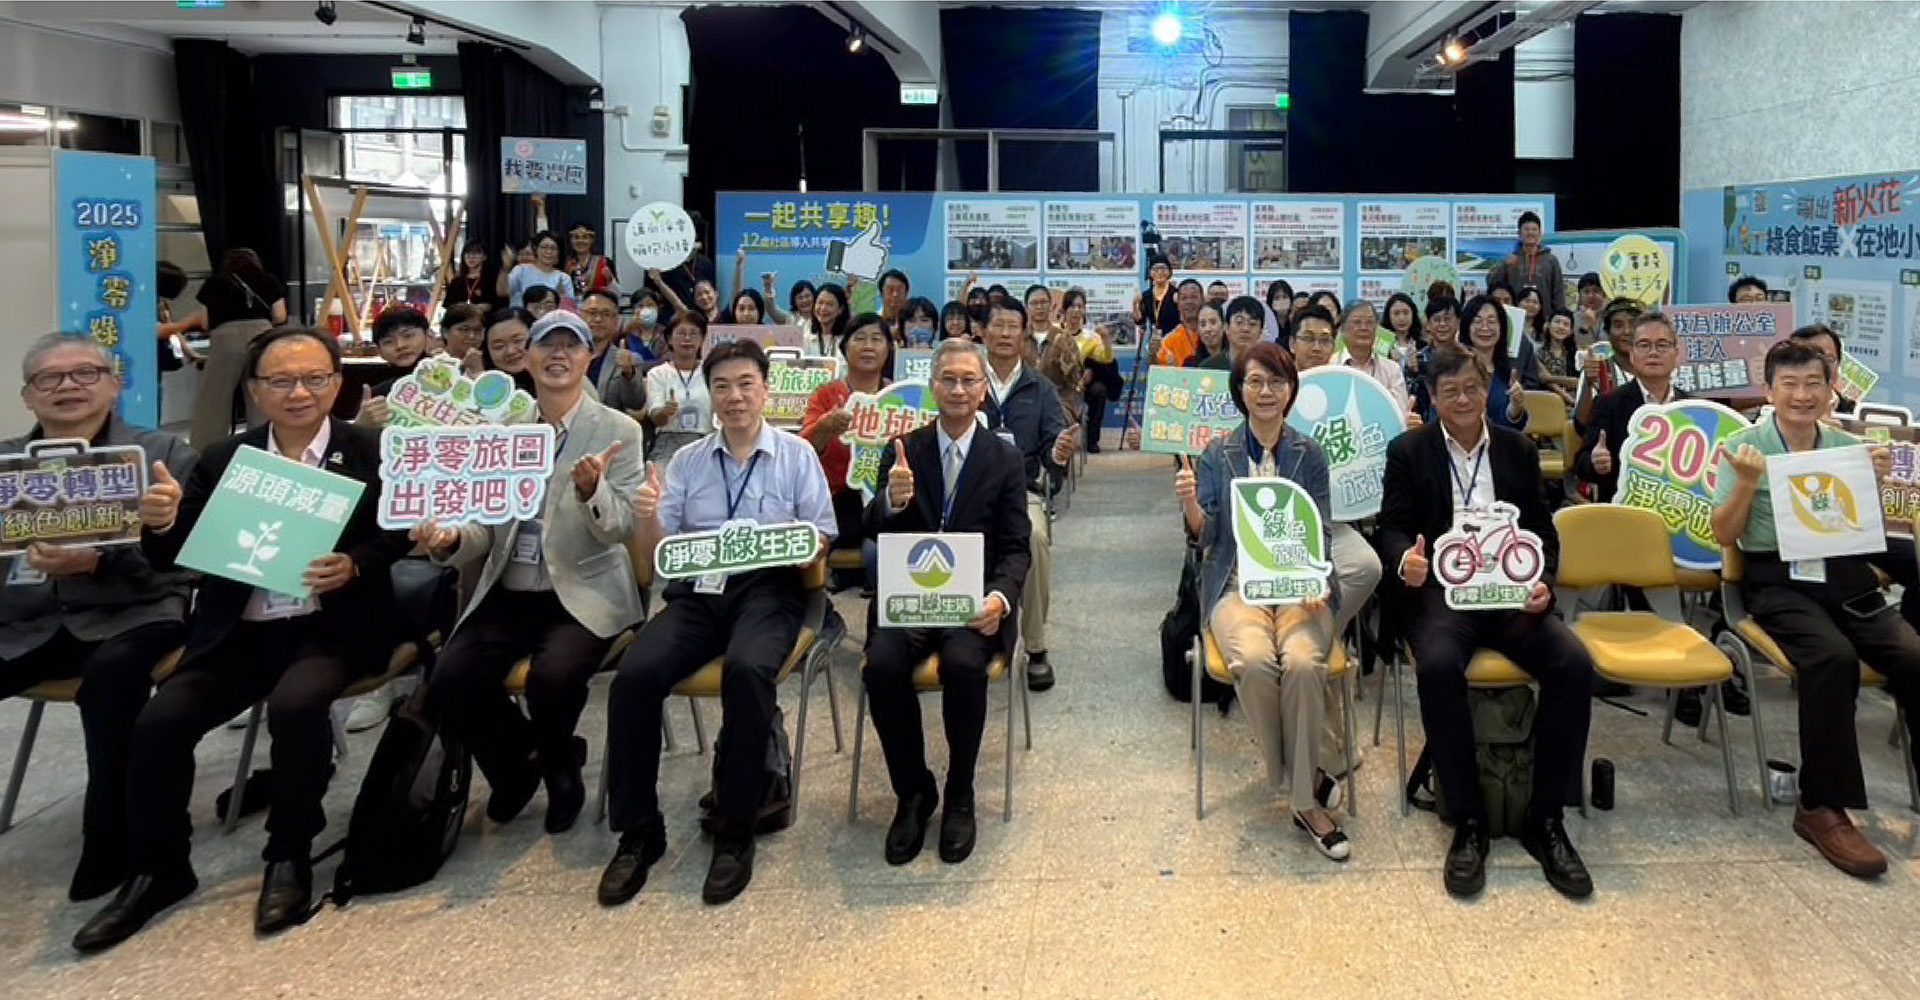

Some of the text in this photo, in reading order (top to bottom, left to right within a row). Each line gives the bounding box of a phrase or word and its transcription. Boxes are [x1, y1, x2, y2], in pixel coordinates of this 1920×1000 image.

[77, 202, 138, 226] 2025
[1688, 338, 1727, 361] 注入
[1313, 418, 1387, 464] 綠色
[224, 463, 351, 525] 源頭減量
[664, 525, 811, 572] 淨零綠生活
[889, 593, 970, 614] 淨零綠生活
